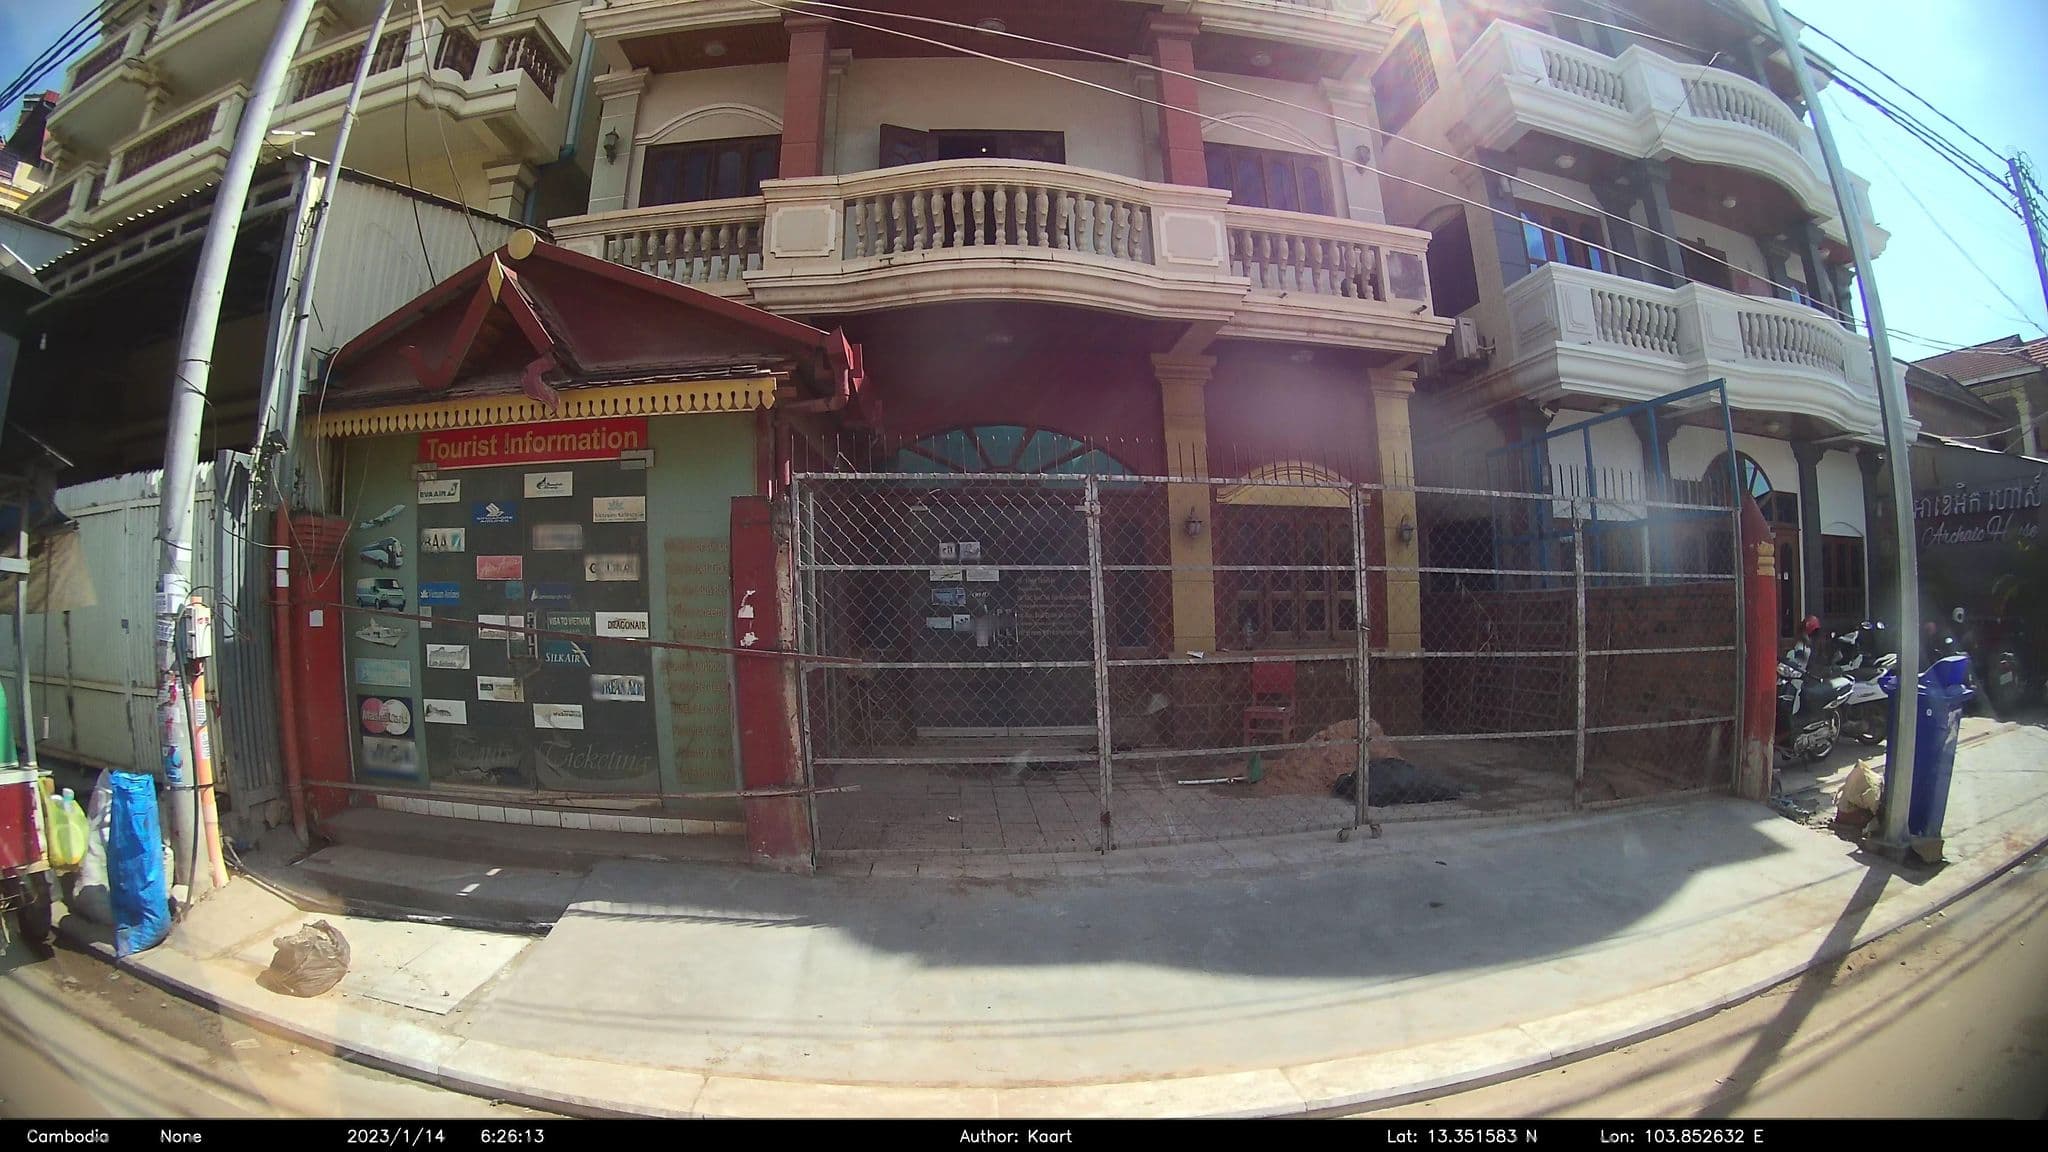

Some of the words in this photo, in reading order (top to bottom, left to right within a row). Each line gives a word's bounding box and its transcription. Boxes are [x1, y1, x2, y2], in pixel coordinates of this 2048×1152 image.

[427, 433, 497, 460] Tourist
[504, 427, 638, 455] Information
[607, 620, 647, 630] DRAGONAIR
